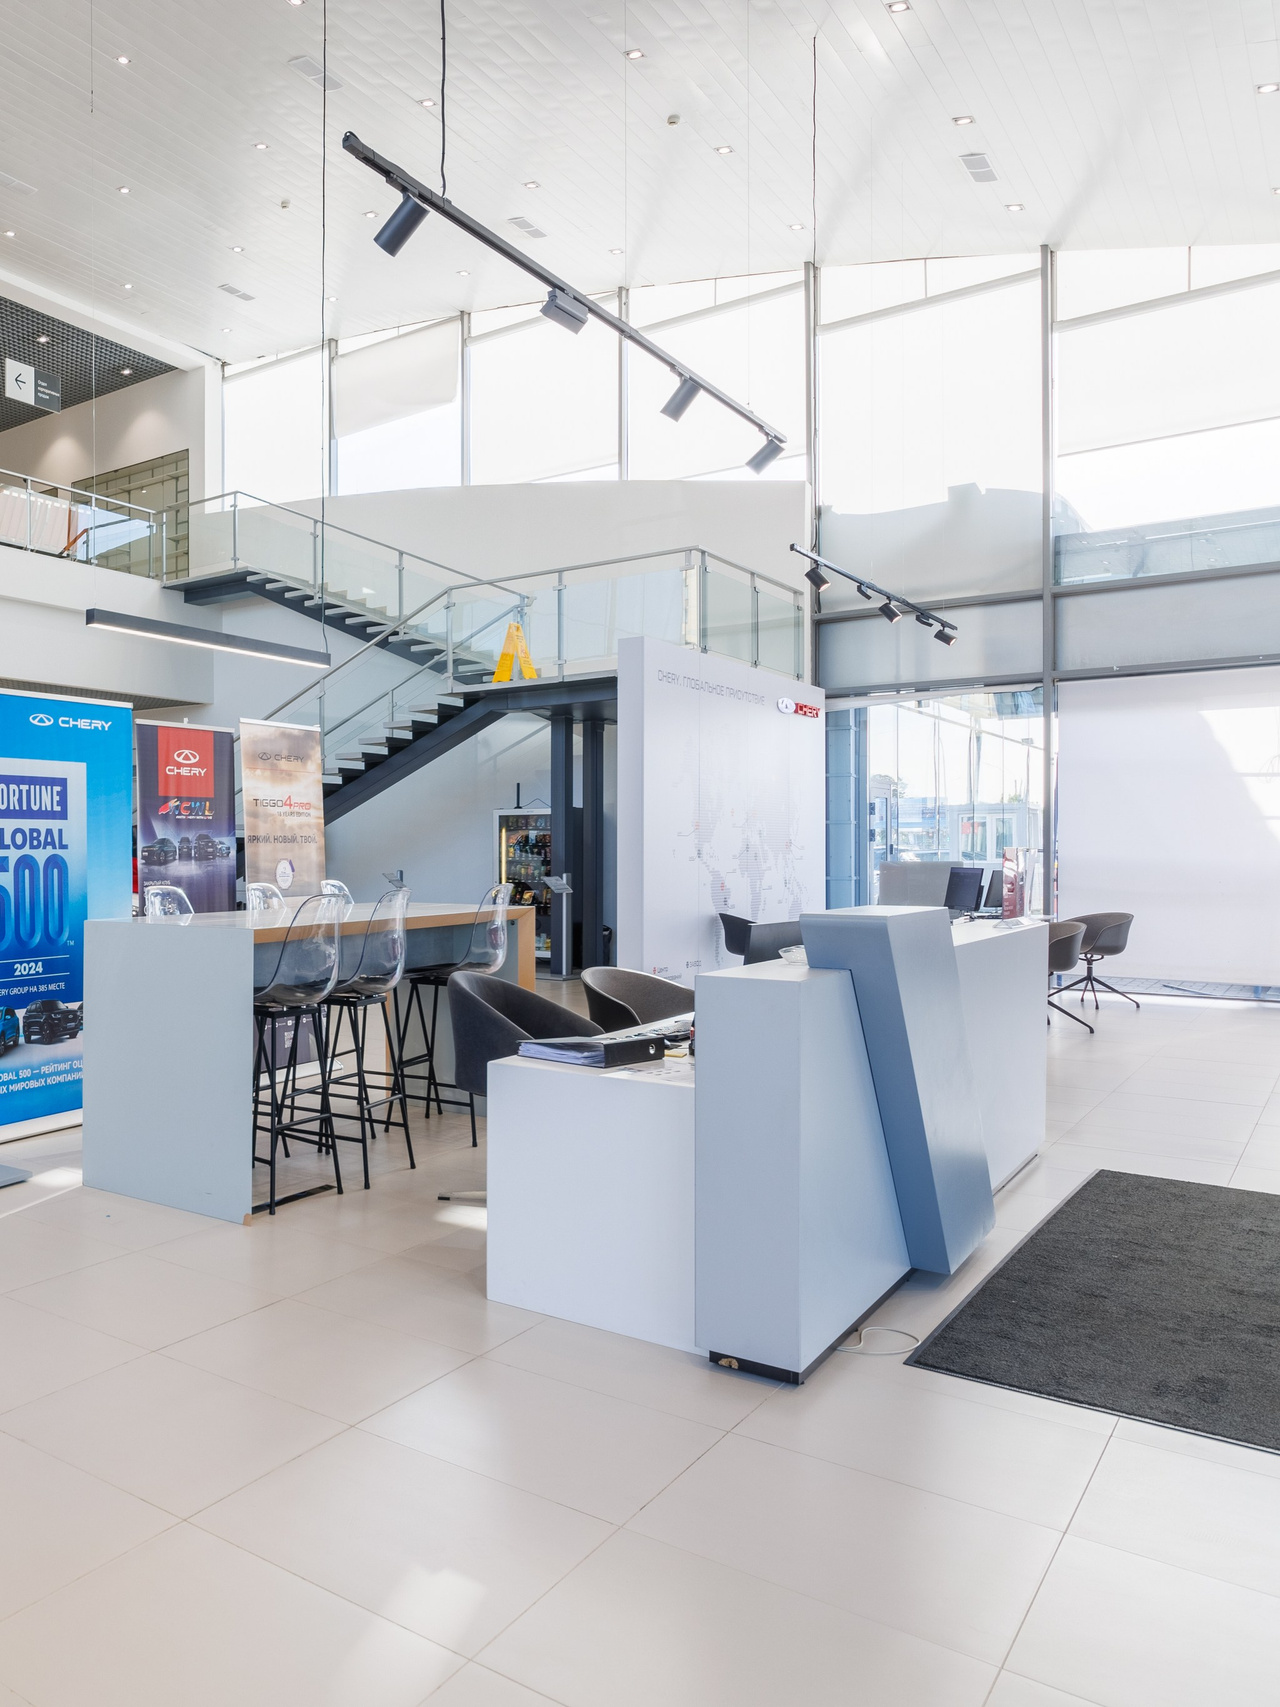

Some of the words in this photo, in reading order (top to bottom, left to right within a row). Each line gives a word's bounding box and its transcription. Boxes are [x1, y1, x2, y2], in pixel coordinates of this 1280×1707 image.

[682, 676, 724, 697] ГЛОБАЛЬНОЕ
[725, 686, 766, 706] ПРИСУТСТВИЕ
[797, 703, 821, 718] CHERY
[58, 716, 112, 731] CHERY
[274, 755, 304, 763] CHERY
[165, 765, 207, 777] CHERY
[253, 798, 284, 808] TIGGO
[247, 833, 272, 844] ЯРКИЙ.
[273, 833, 299, 844] НОВЫЙ.
[13, 962, 43, 976] 2024
[9, 986, 29, 996] GROUP
[29, 985, 38, 993] НА
[38, 984, 48, 992] 385
[48, 982, 66, 991] МЕСТЕ
[18, 1068, 32, 1079] 500
[41, 1061, 72, 1075] РЕЙТИНГ
[8, 1078, 46, 1093] МИРОВЫХ
[46, 1071, 83, 1086] КОМПАНИ
